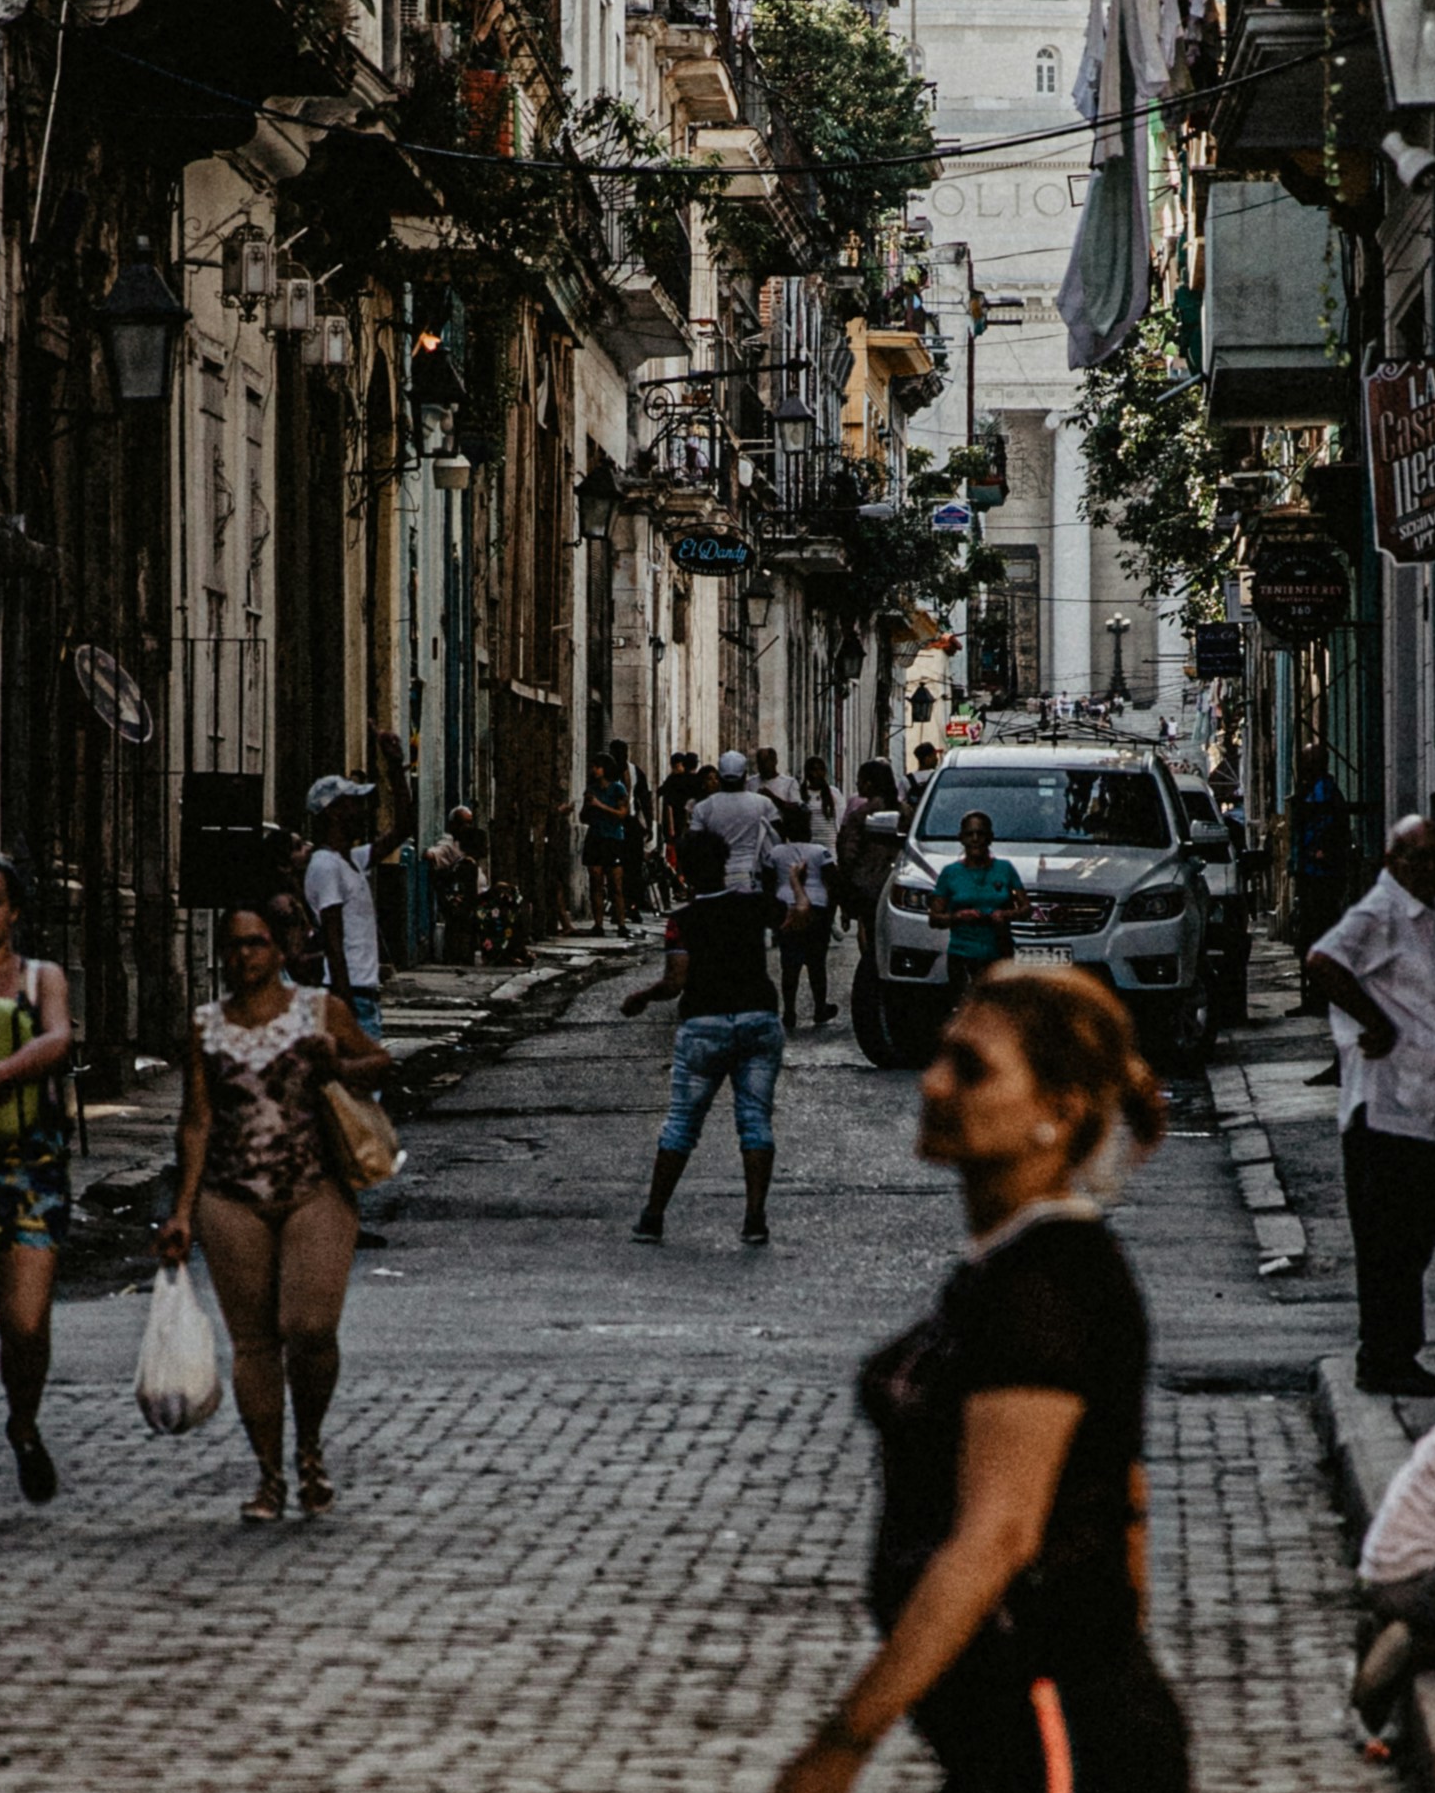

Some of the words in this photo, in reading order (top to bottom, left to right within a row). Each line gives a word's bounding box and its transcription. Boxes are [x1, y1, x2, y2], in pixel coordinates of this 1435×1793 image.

[932, 183, 1067, 218] OLIO
[678, 537, 697, 559] El
[698, 538, 748, 564] Dandy
[1414, 528, 1435, 551] APT
[1259, 585, 1317, 595] TENIENTE
[1321, 585, 1343, 595] REY
